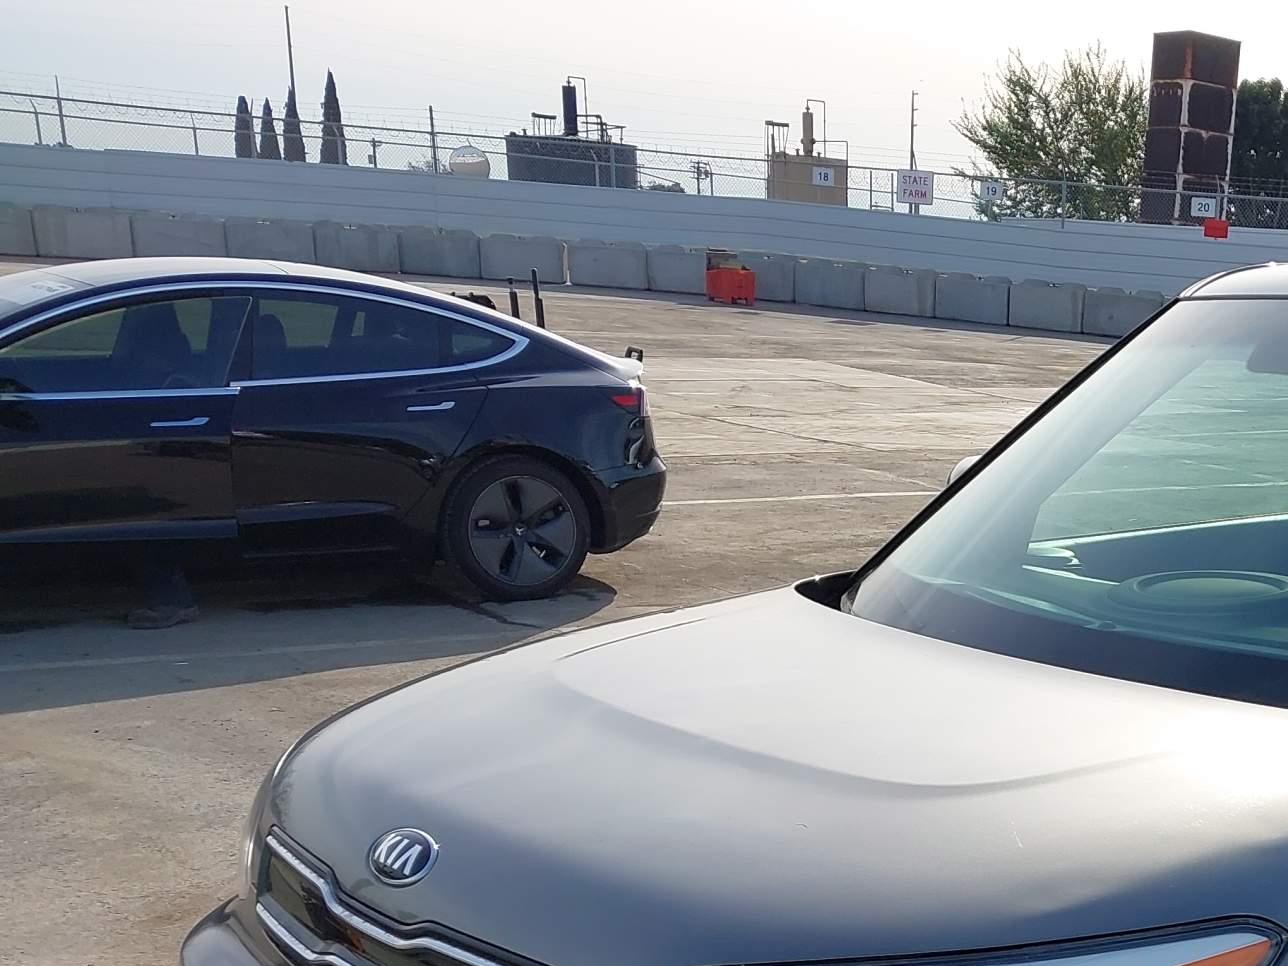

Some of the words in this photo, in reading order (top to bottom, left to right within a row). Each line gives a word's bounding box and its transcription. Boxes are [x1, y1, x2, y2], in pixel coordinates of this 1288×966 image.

[818, 171, 829, 181] 18
[902, 175, 929, 186] STATE
[903, 188, 927, 199] FARM
[986, 186, 997, 196] 19
[1197, 202, 1210, 212] 20
[374, 832, 423, 876] KIA
